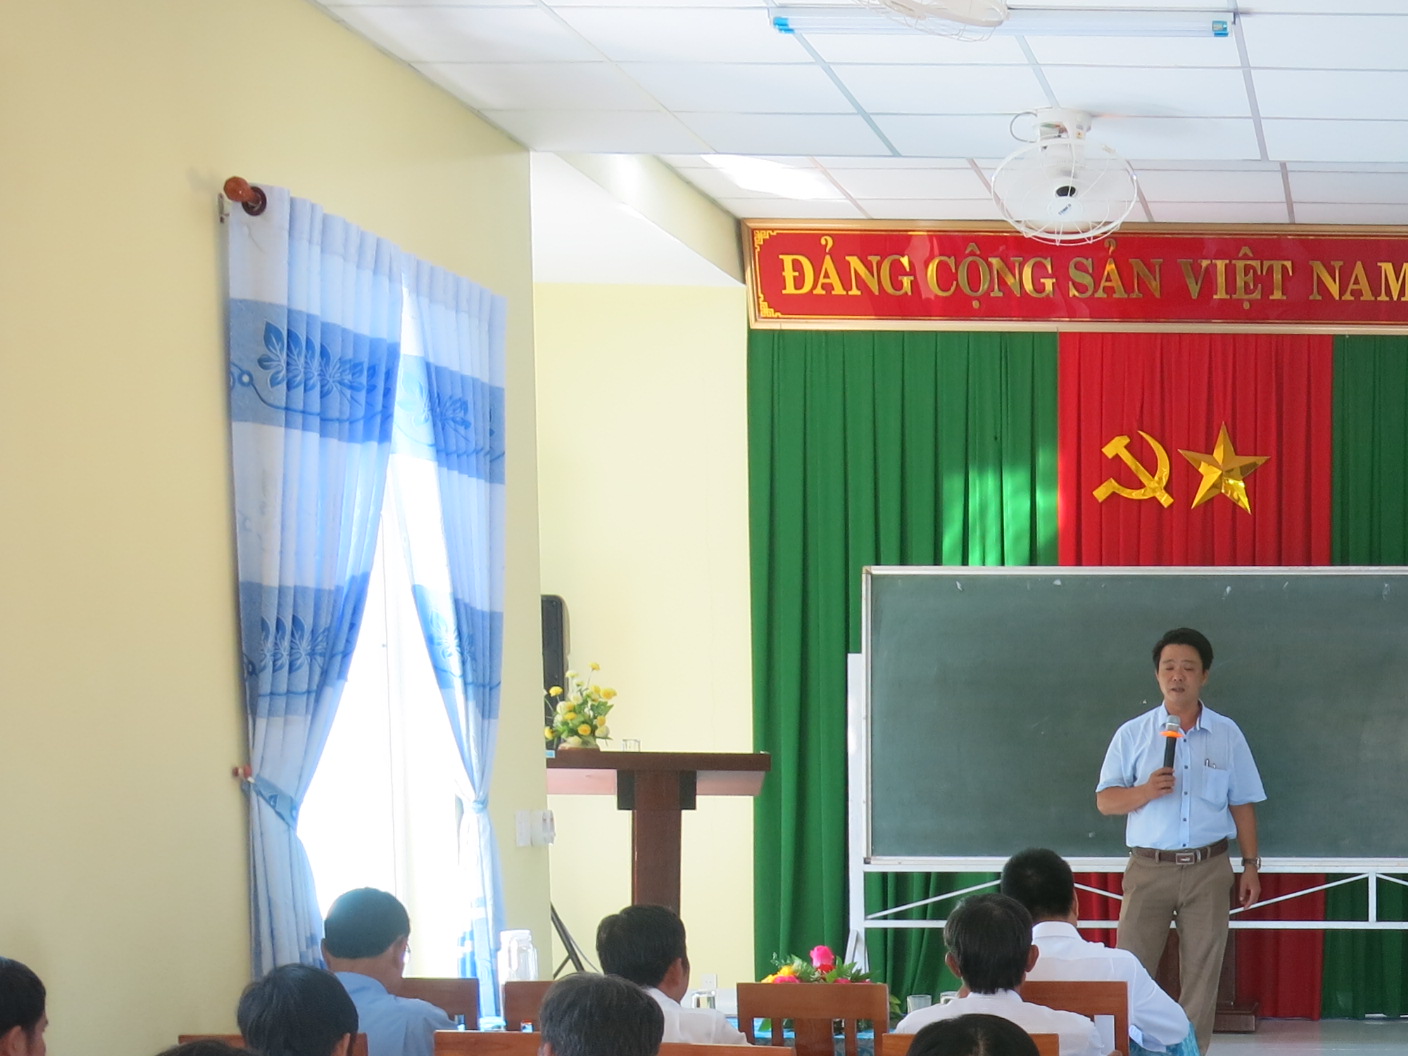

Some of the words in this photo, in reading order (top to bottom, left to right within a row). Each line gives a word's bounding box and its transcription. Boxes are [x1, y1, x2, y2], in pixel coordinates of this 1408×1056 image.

[779, 236, 912, 297] ĐẢNG
[927, 242, 1056, 310] CỘNG
[1068, 238, 1164, 299] SẢN
[1178, 246, 1295, 311] VIỆT
